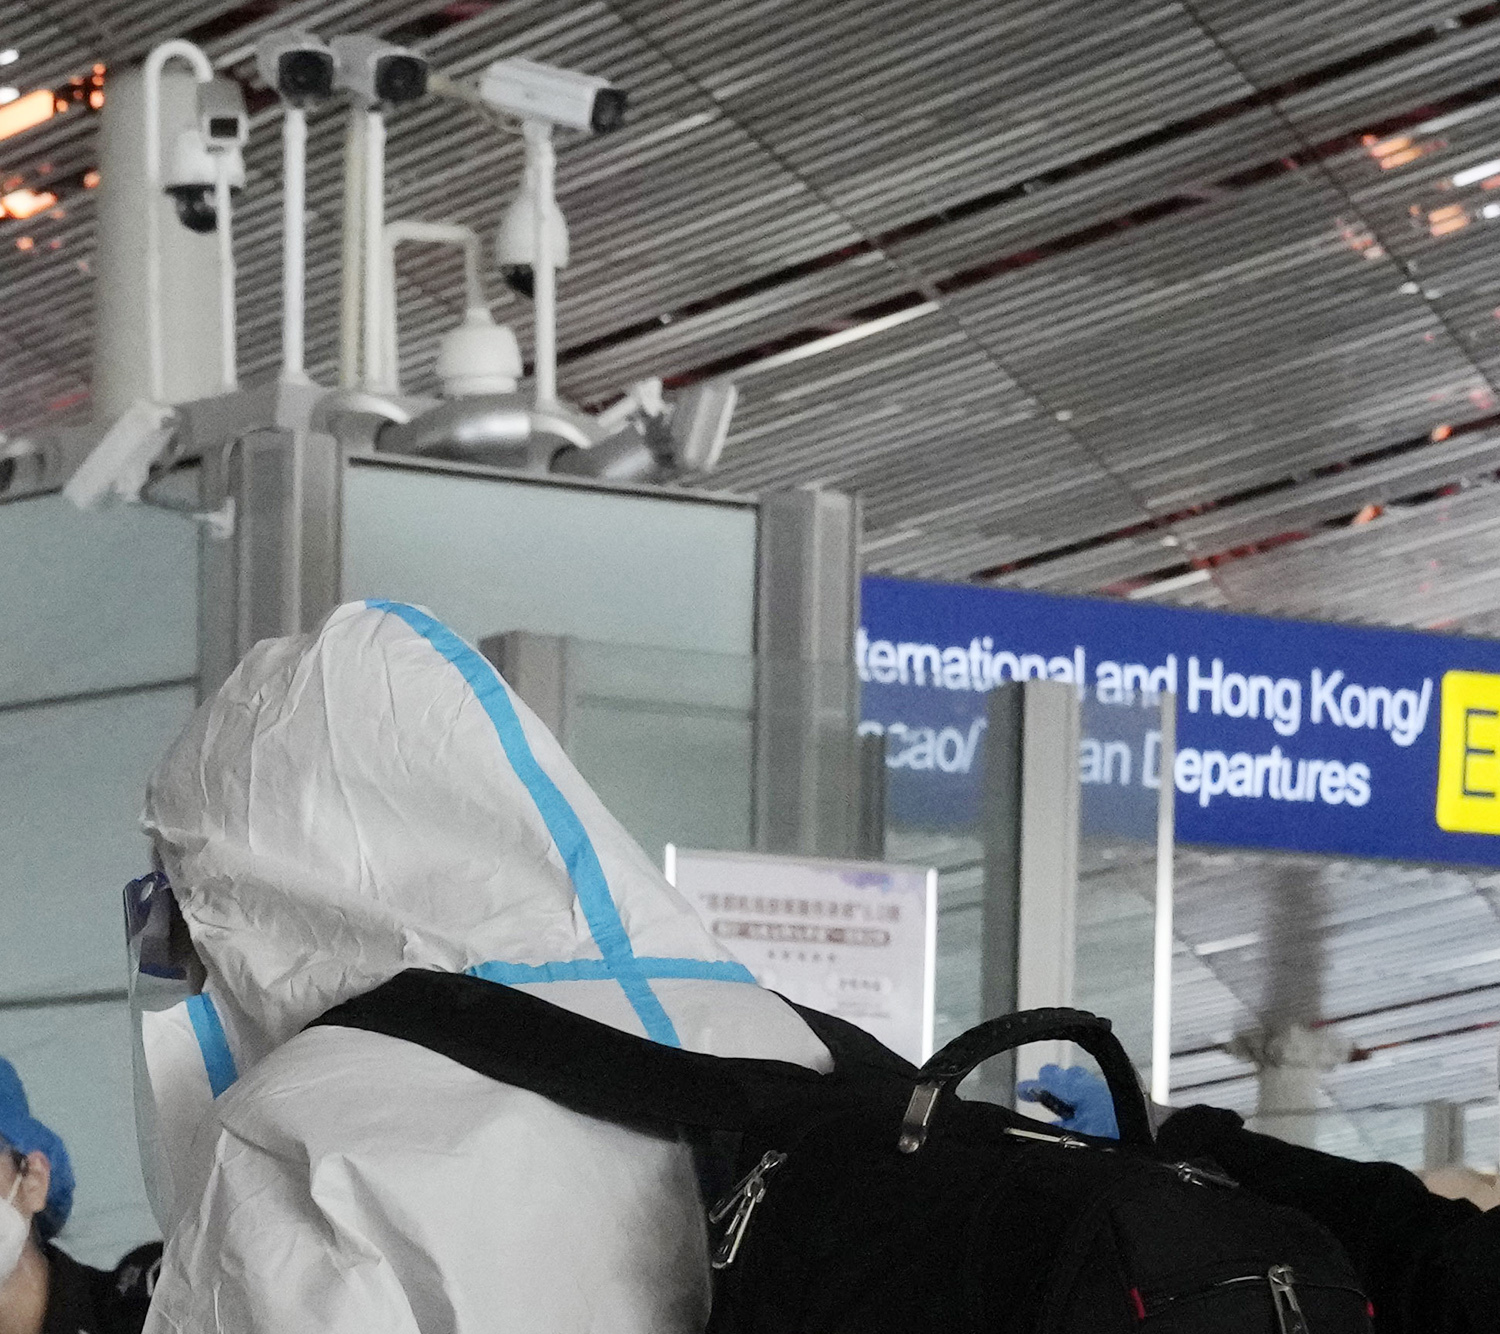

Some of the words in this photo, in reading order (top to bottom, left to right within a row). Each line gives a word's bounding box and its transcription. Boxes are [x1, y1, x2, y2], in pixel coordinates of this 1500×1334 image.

[854, 627, 1085, 699] ternational
[1095, 654, 1177, 707] and
[1187, 656, 1302, 736] Hong
[1310, 668, 1433, 747] Kong/
